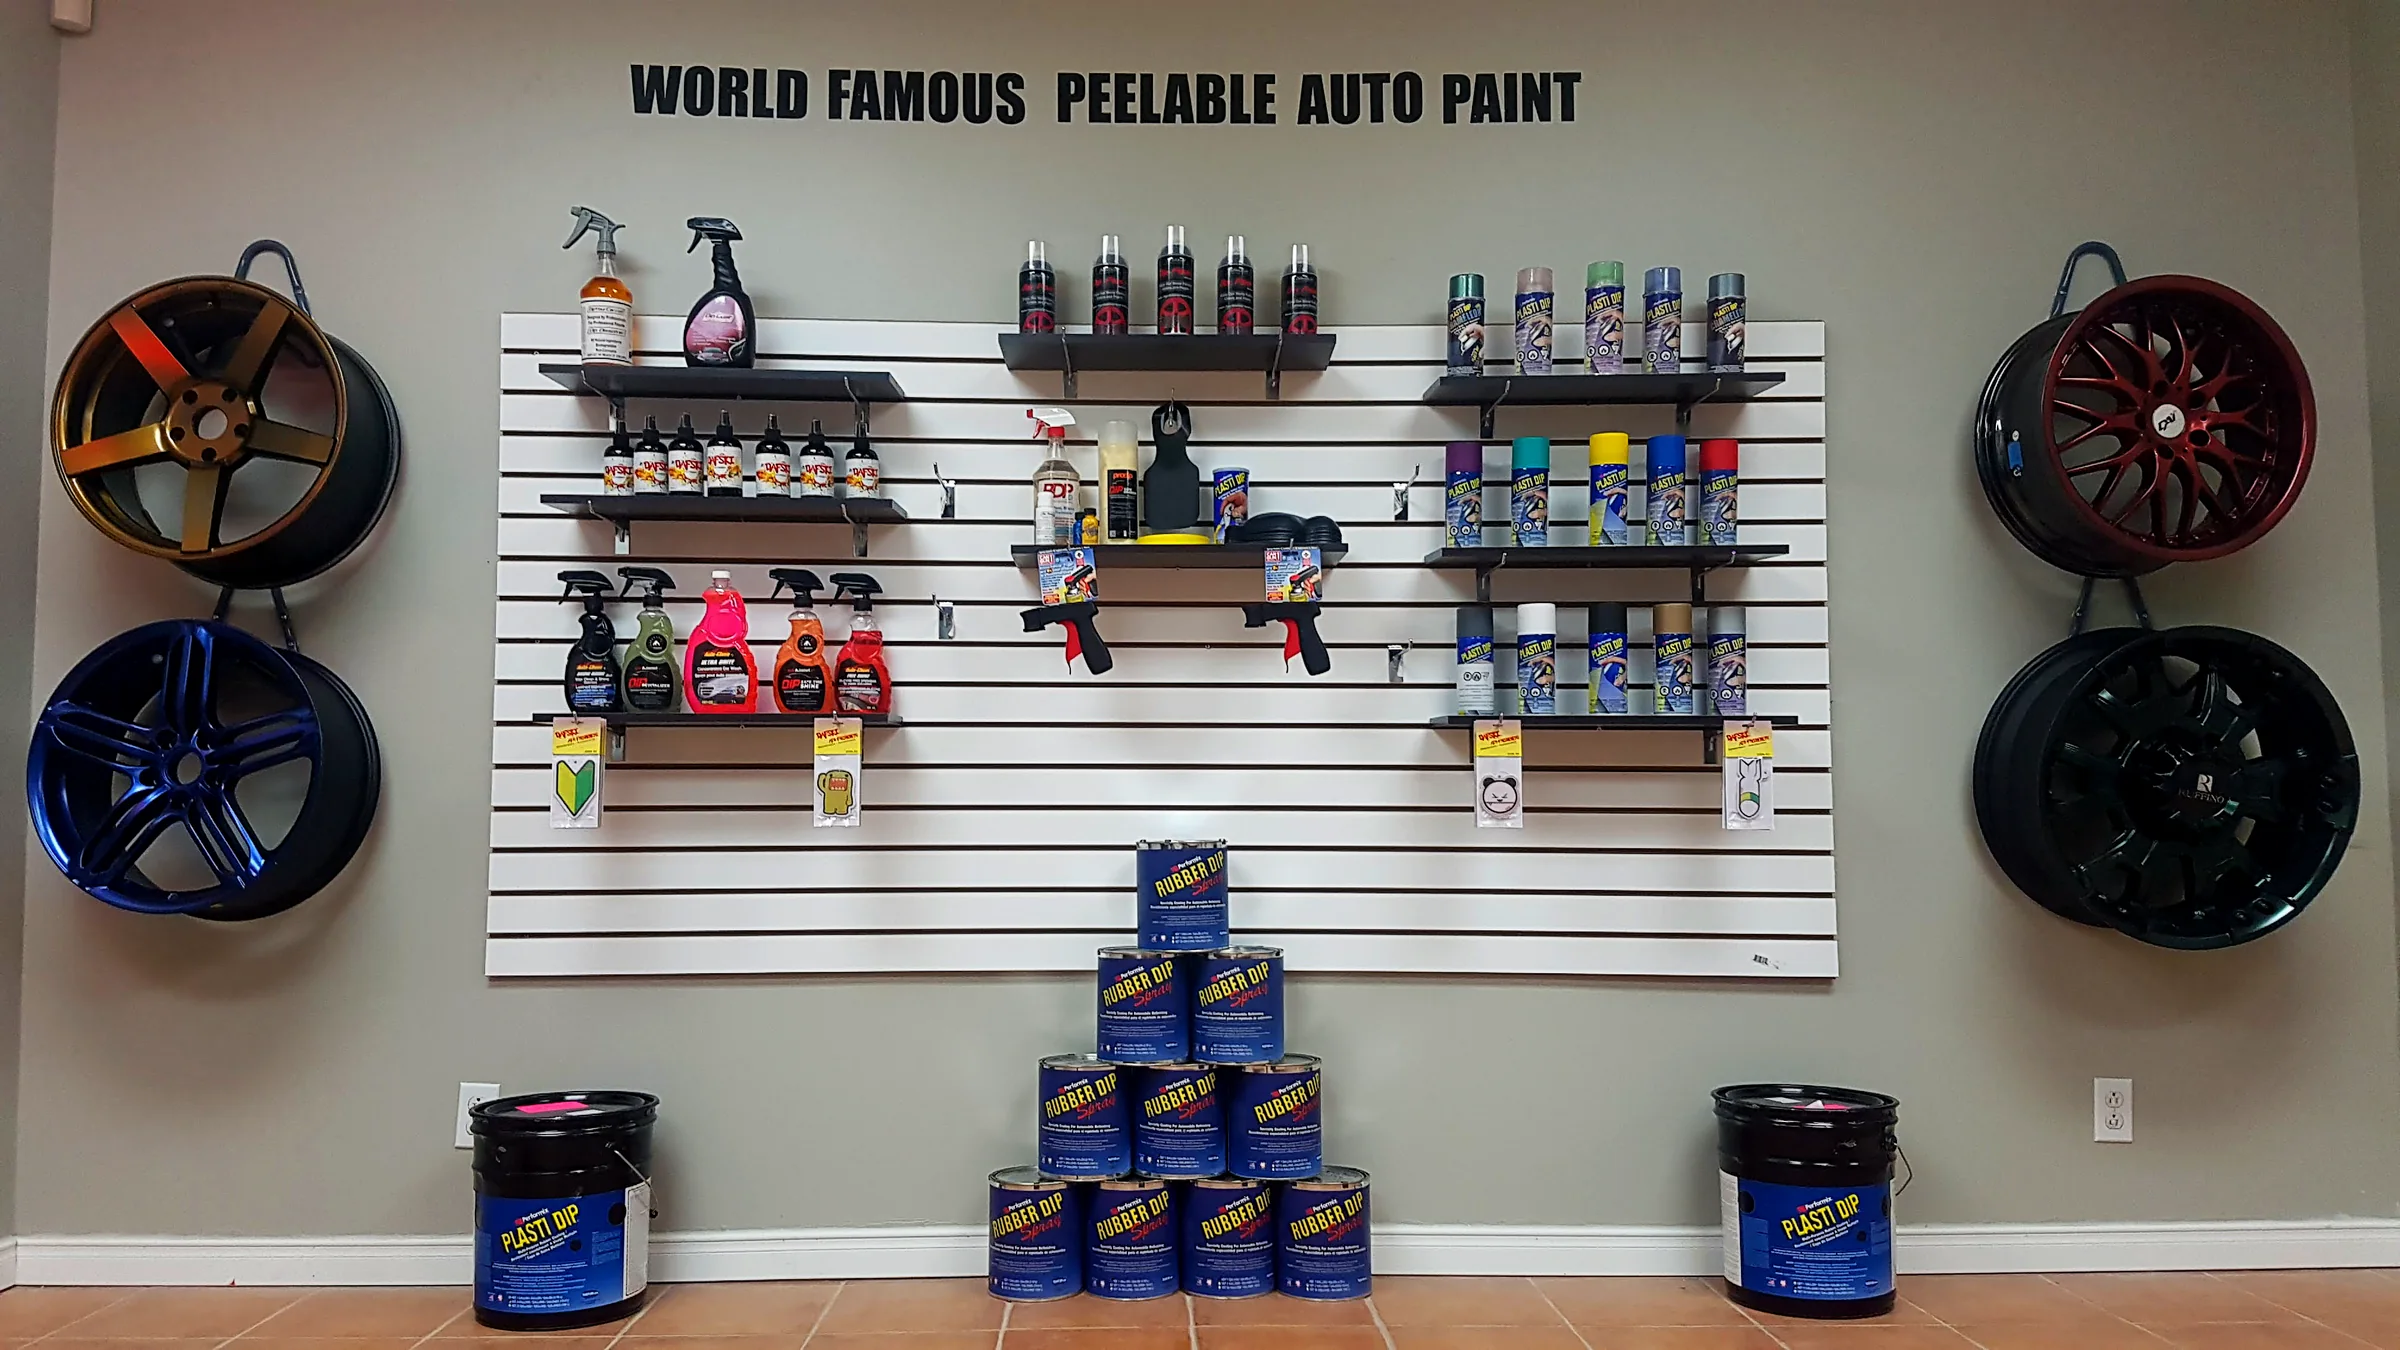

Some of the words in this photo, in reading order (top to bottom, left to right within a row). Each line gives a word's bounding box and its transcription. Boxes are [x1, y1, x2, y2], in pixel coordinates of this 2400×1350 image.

[631, 65, 807, 118] WORLD
[829, 70, 1025, 124] FAMOUS
[1058, 73, 1276, 124] PEELABLE
[1297, 72, 1422, 124] AUTO
[1443, 72, 1581, 124] PAINT
[1516, 302, 1538, 321] PLASTI
[1586, 296, 1610, 314] PLASTI
[1646, 303, 1671, 321] PLASTI
[1215, 479, 1236, 498] PLASTI
[1448, 481, 1470, 499] PLASTI
[1512, 477, 1534, 494] PLASTI
[1596, 473, 1618, 490] PLASTI
[1651, 477, 1674, 493] PLASTI
[1704, 479, 1728, 494] PLASTI
[1461, 646, 1483, 663] PLASTI
[1519, 643, 1541, 659] PLASTI
[1591, 642, 1614, 658] PLASTI
[1658, 641, 1682, 658] PLASTI
[1154, 862, 1208, 898] RUBBER
[1207, 850, 1224, 874] DIP
[1102, 972, 1152, 1007] RUBBER
[1150, 960, 1174, 985] DIP
[1133, 981, 1172, 1008] Spray
[1198, 972, 1248, 1008] RUBBER
[1247, 961, 1270, 986] DIP
[1045, 1084, 1096, 1119] RUBBER
[1095, 1072, 1117, 1097] DIP
[1144, 1083, 1198, 1118] RUBBER
[1196, 1072, 1216, 1096] DIP
[1254, 1086, 1308, 1124] RUBBER
[1202, 1202, 1257, 1240] RUBBER
[1254, 1188, 1271, 1214] DIP
[1805, 1196, 1832, 1210] Performix
[522, 1208, 550, 1222] Performix
[992, 1204, 1040, 1239] RUBBER
[1038, 1192, 1064, 1218] DIP
[1096, 1205, 1151, 1240] RUBBER
[1148, 1190, 1170, 1216] DIP
[1290, 1206, 1346, 1240] RUBBER
[1344, 1191, 1364, 1217] DIP
[1781, 1205, 1836, 1240] PLASTI
[1835, 1193, 1860, 1220] DIP
[501, 1217, 552, 1254] PLASTI
[552, 1204, 579, 1230] DIP
[1020, 1214, 1061, 1242] Spray
